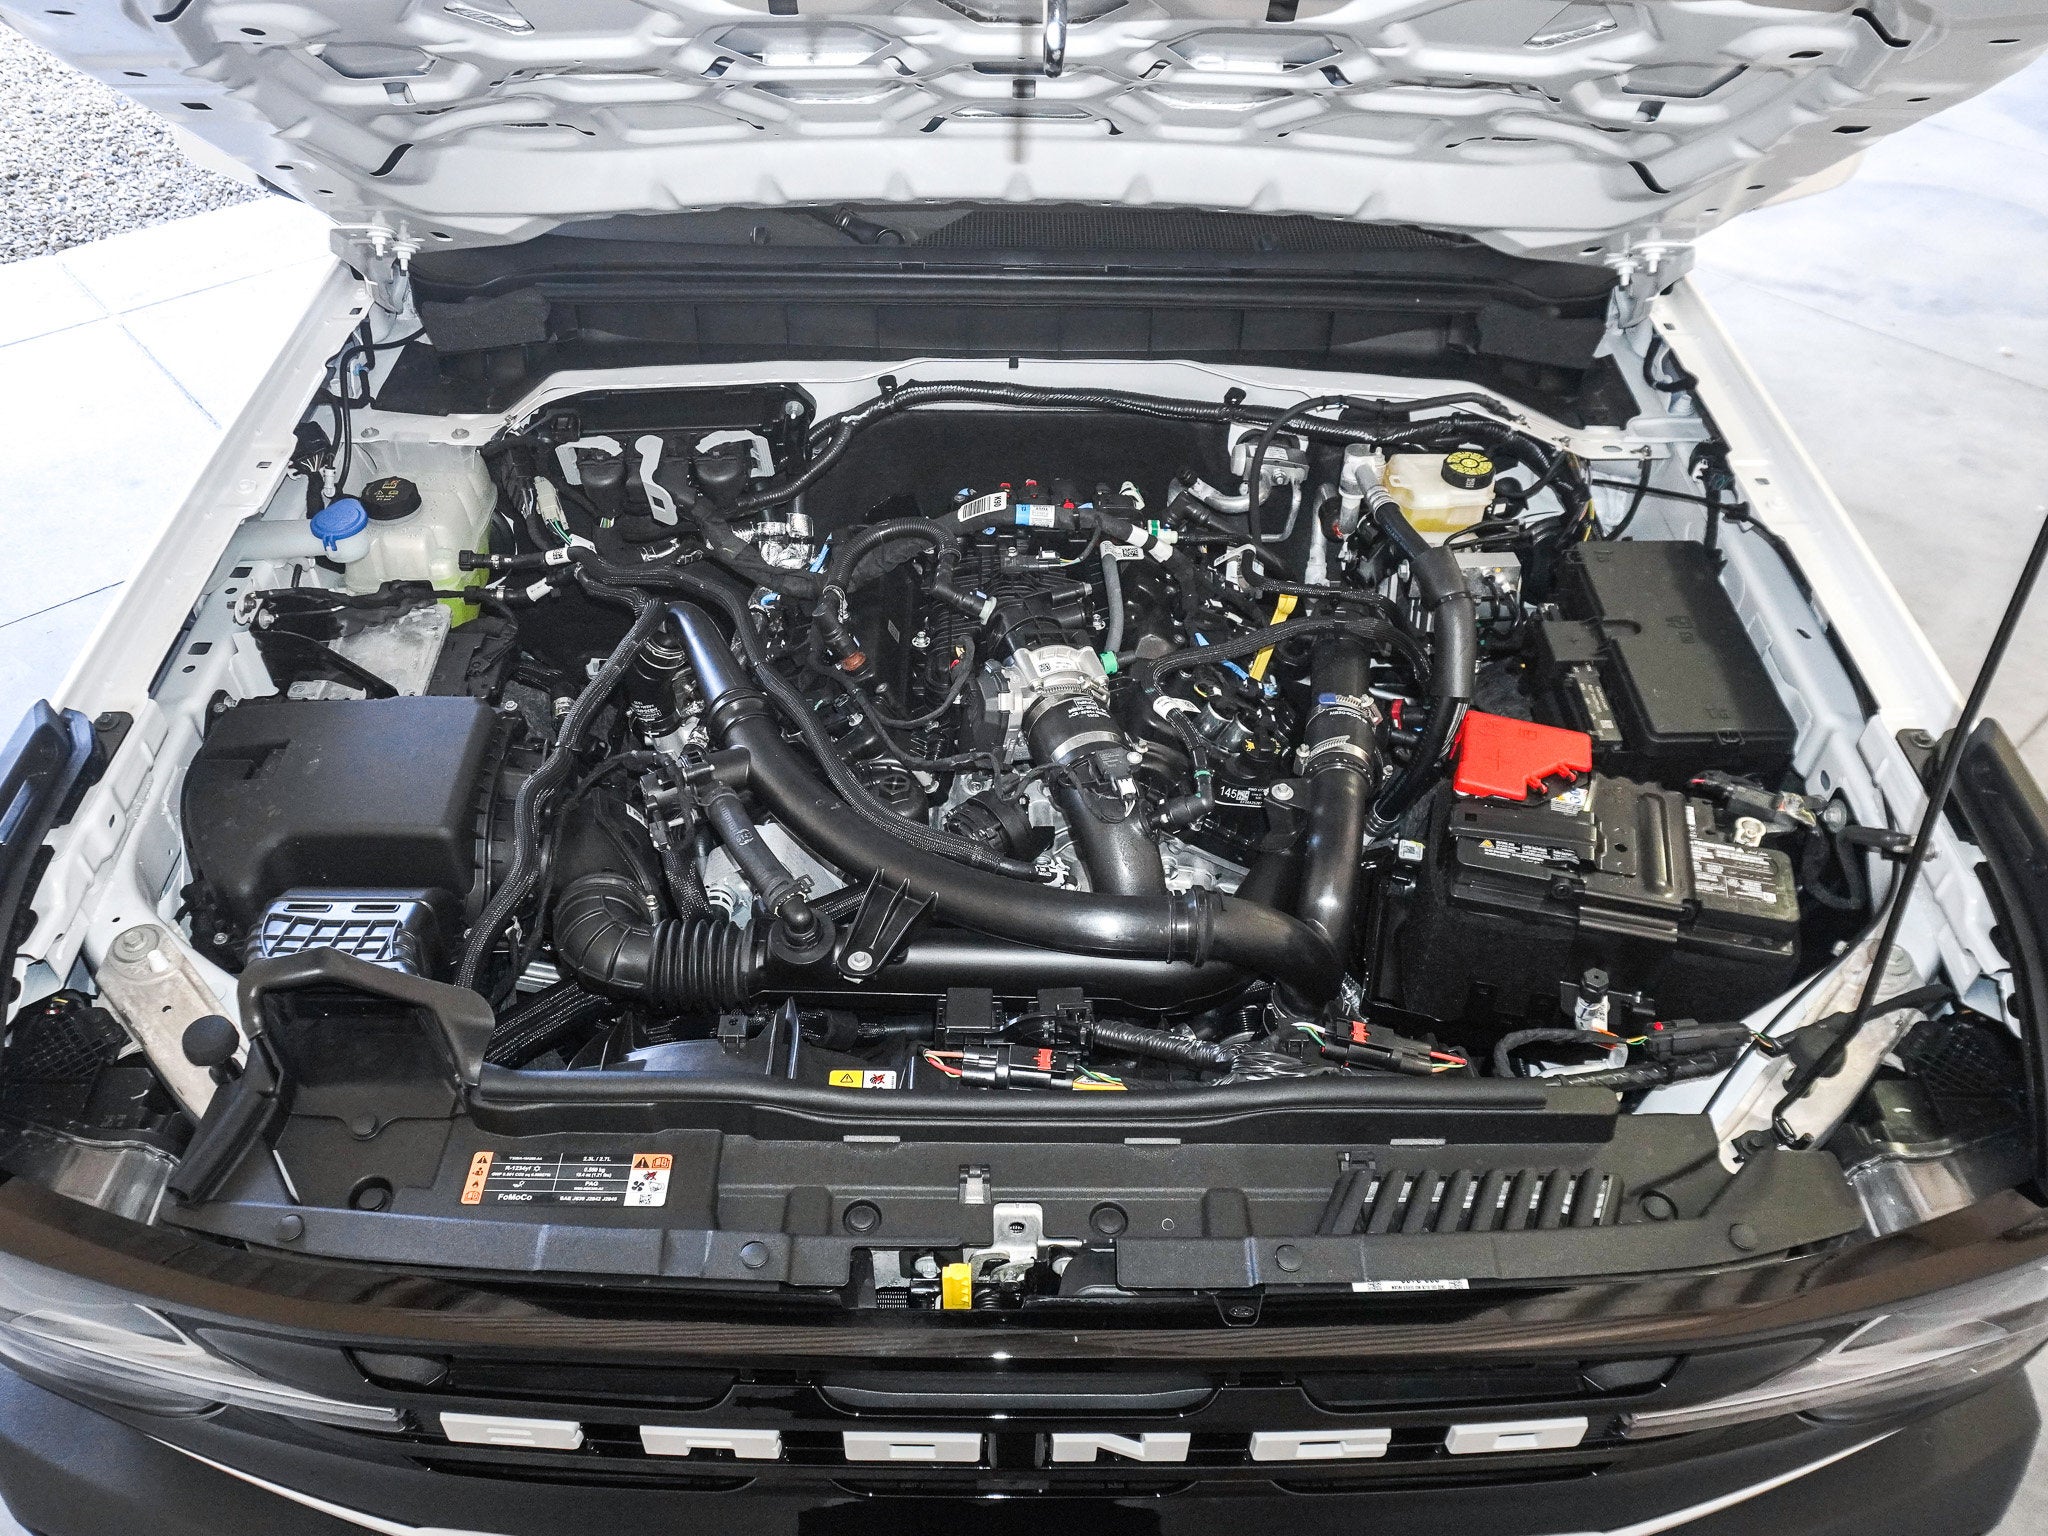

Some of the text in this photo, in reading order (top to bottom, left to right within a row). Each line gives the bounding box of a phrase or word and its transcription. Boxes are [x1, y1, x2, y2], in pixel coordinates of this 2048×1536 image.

[1220, 786, 1238, 799] 145
[497, 1193, 533, 1201] FoMoCo
[439, 1411, 1589, 1463] BRONCO
